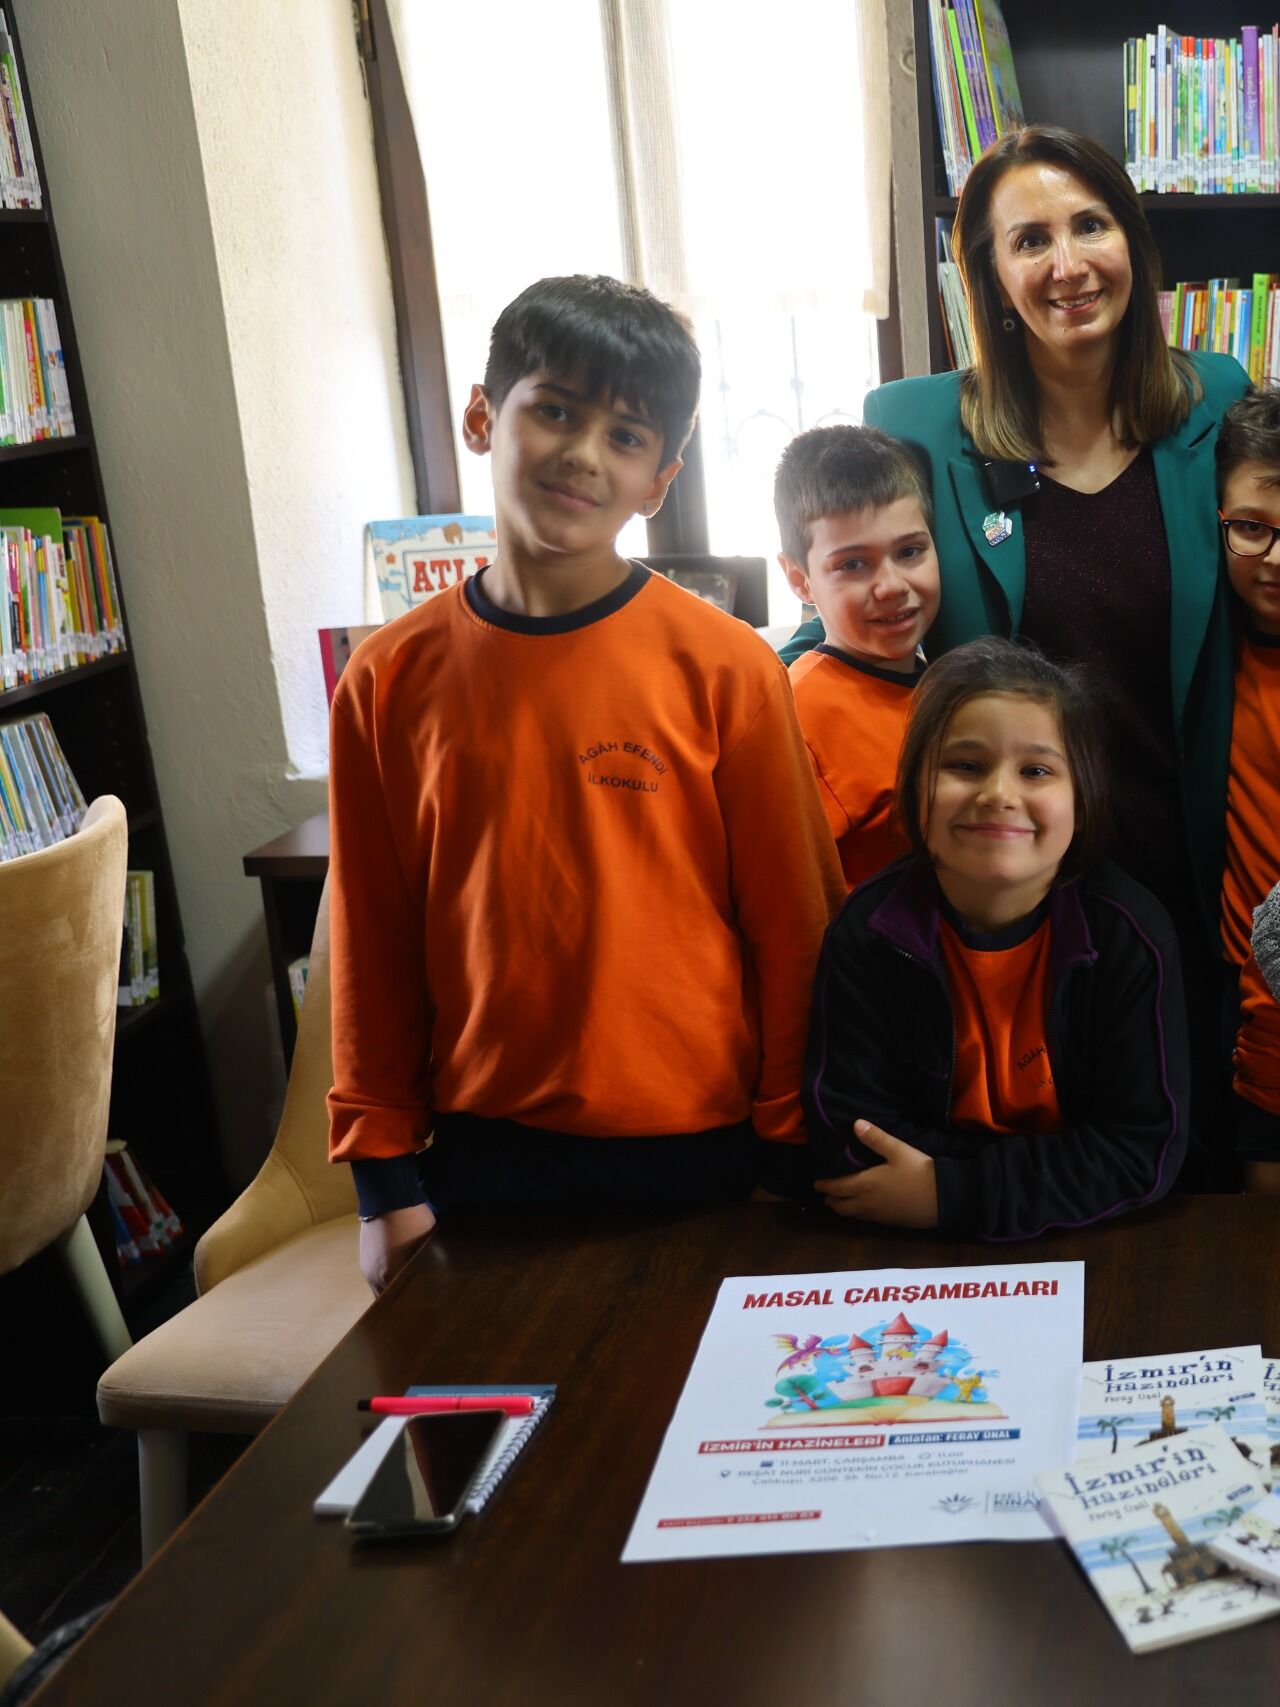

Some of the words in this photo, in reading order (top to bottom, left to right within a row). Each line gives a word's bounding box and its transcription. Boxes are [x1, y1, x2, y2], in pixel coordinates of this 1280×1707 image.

[742, 1288, 834, 1310] MASAL
[844, 1280, 1059, 1306] ÇARŞAMBALARI
[1104, 1355, 1233, 1382] İzmir'in
[1106, 1373, 1234, 1393] Hazineleri
[703, 1439, 774, 1453] İZMİR'İN
[779, 1435, 882, 1449] HAZİNELERİ
[894, 1433, 942, 1444] Anlatan:
[1064, 1444, 1208, 1496] İzmir'in
[1078, 1462, 1218, 1510] Hazineleri
